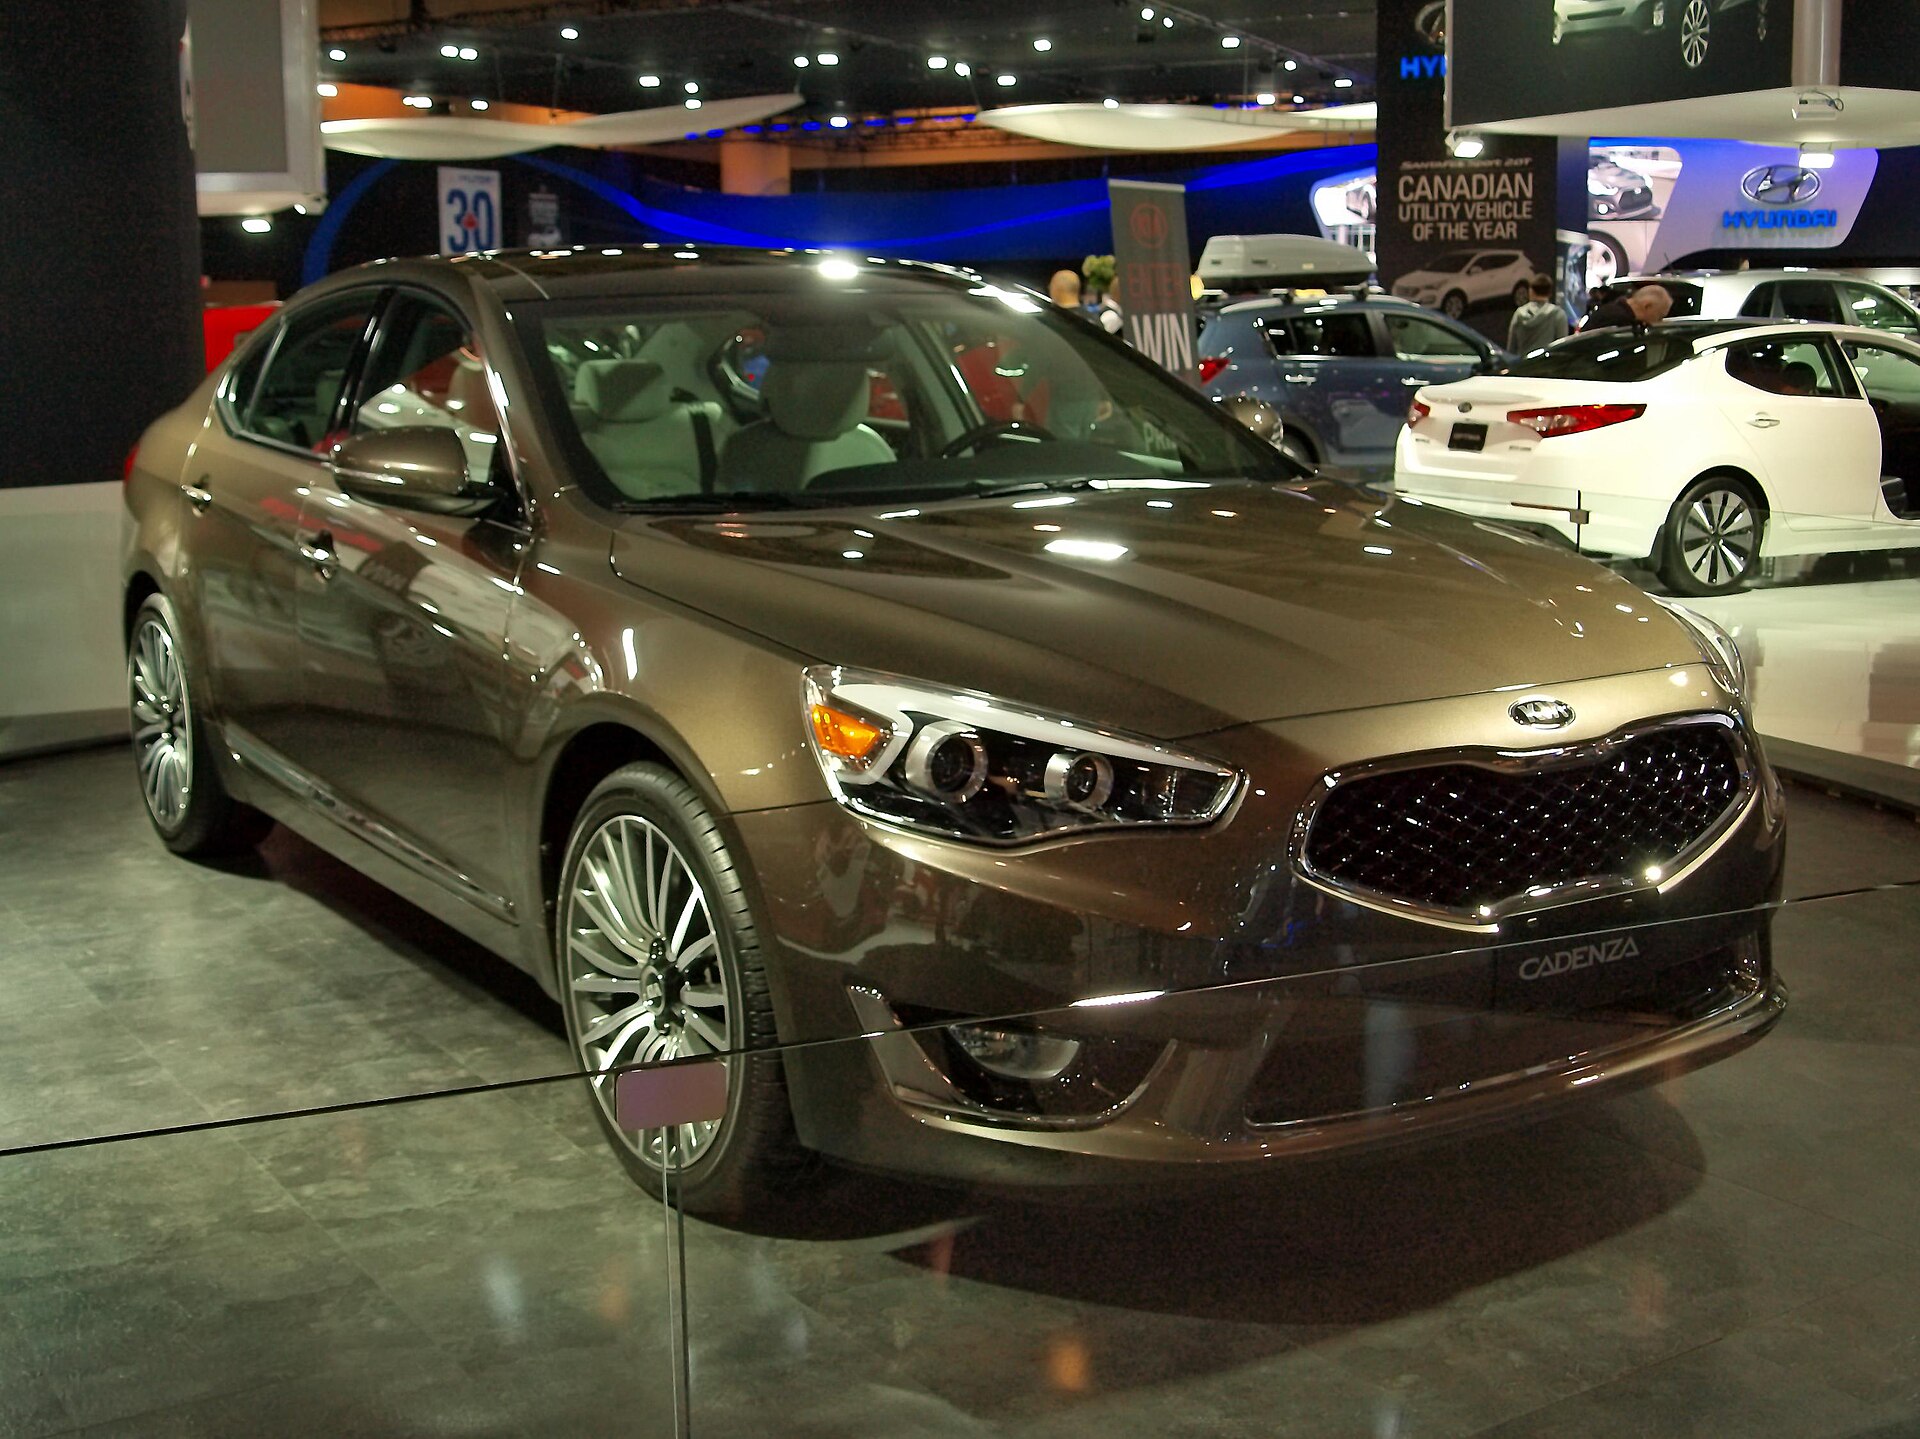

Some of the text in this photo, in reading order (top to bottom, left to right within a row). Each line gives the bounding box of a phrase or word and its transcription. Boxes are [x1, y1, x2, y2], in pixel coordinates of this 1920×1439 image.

[1399, 173, 1533, 202] CANADIAN
[448, 189, 494, 253] 30
[1399, 200, 1533, 223] UTILITY VEHICLE
[1722, 208, 1838, 230] HYUNDAI
[1412, 221, 1518, 242] OF THE YEAR
[1131, 312, 1192, 370] WIN
[1518, 936, 1640, 981] CADENZA
